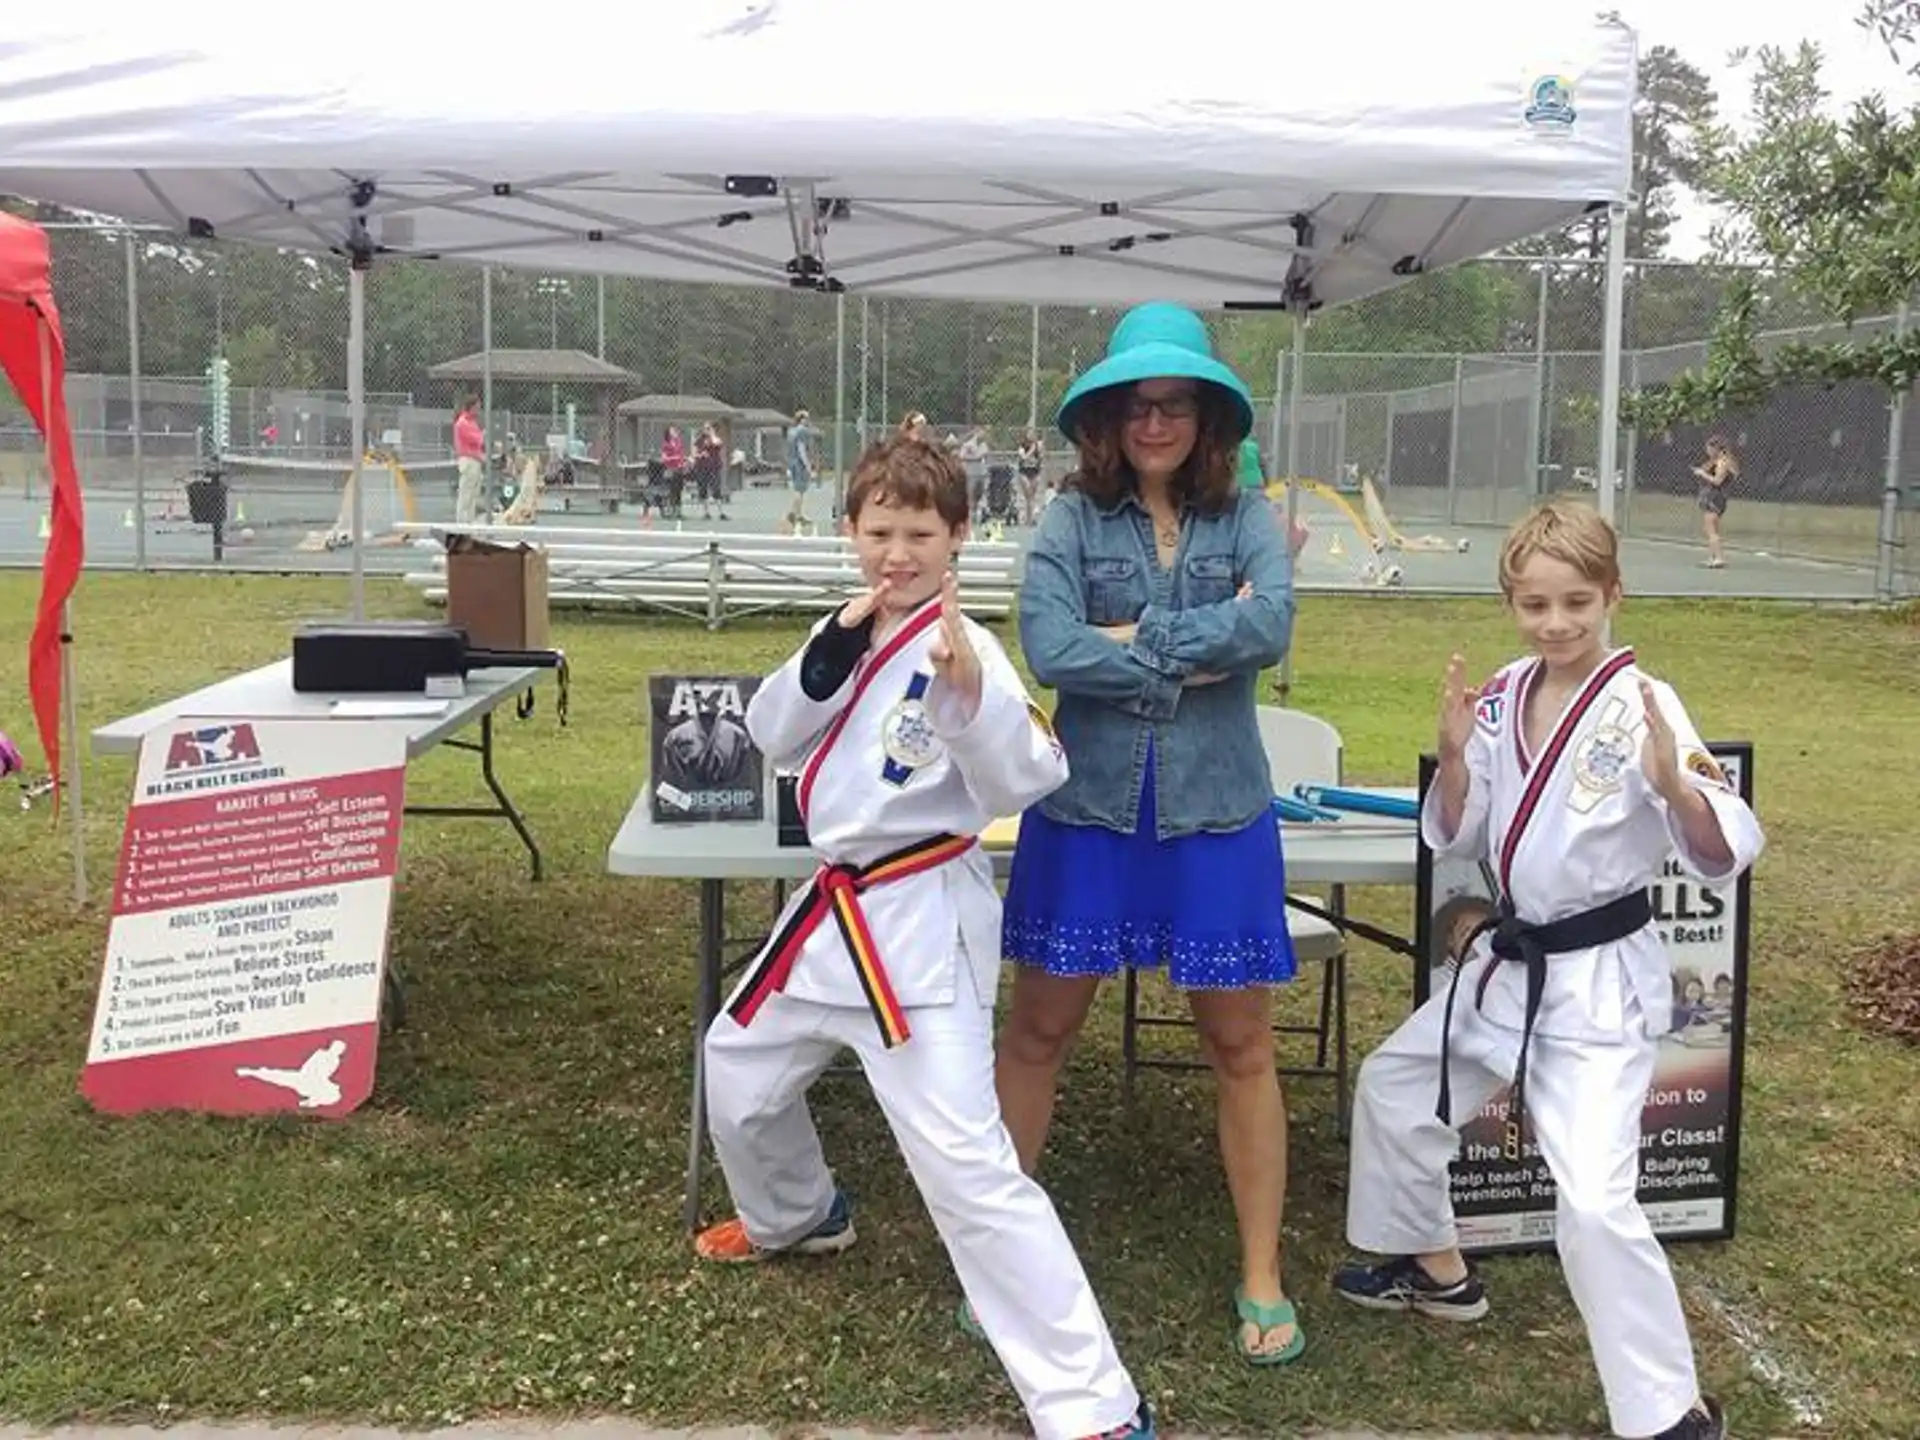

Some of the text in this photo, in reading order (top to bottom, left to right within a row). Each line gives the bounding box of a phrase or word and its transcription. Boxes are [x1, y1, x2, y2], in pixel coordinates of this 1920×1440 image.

[146, 779, 193, 796] BLACK
[197, 773, 227, 789] BELT
[229, 767, 285, 785] SCHOOL
[168, 912, 210, 929] ADULTS
[217, 922, 241, 938] AND
[294, 928, 334, 946] Shape
[1673, 925, 1723, 944] Best!
[233, 956, 281, 975] Relieve
[281, 949, 326, 968] Stress
[250, 970, 303, 991] Develop
[305, 961, 378, 983] Confidence
[213, 999, 246, 1017] Save
[248, 994, 278, 1011] Your
[280, 988, 306, 1007] Life
[215, 1018, 241, 1037] Fun
[1686, 1087, 1707, 1104] to
[1466, 1143, 1501, 1161] the
[1660, 1124, 1725, 1147] Class!
[1487, 1167, 1533, 1186] teach
[1644, 1154, 1710, 1177] Bullying
[1640, 1169, 1721, 1190] Discipline.
